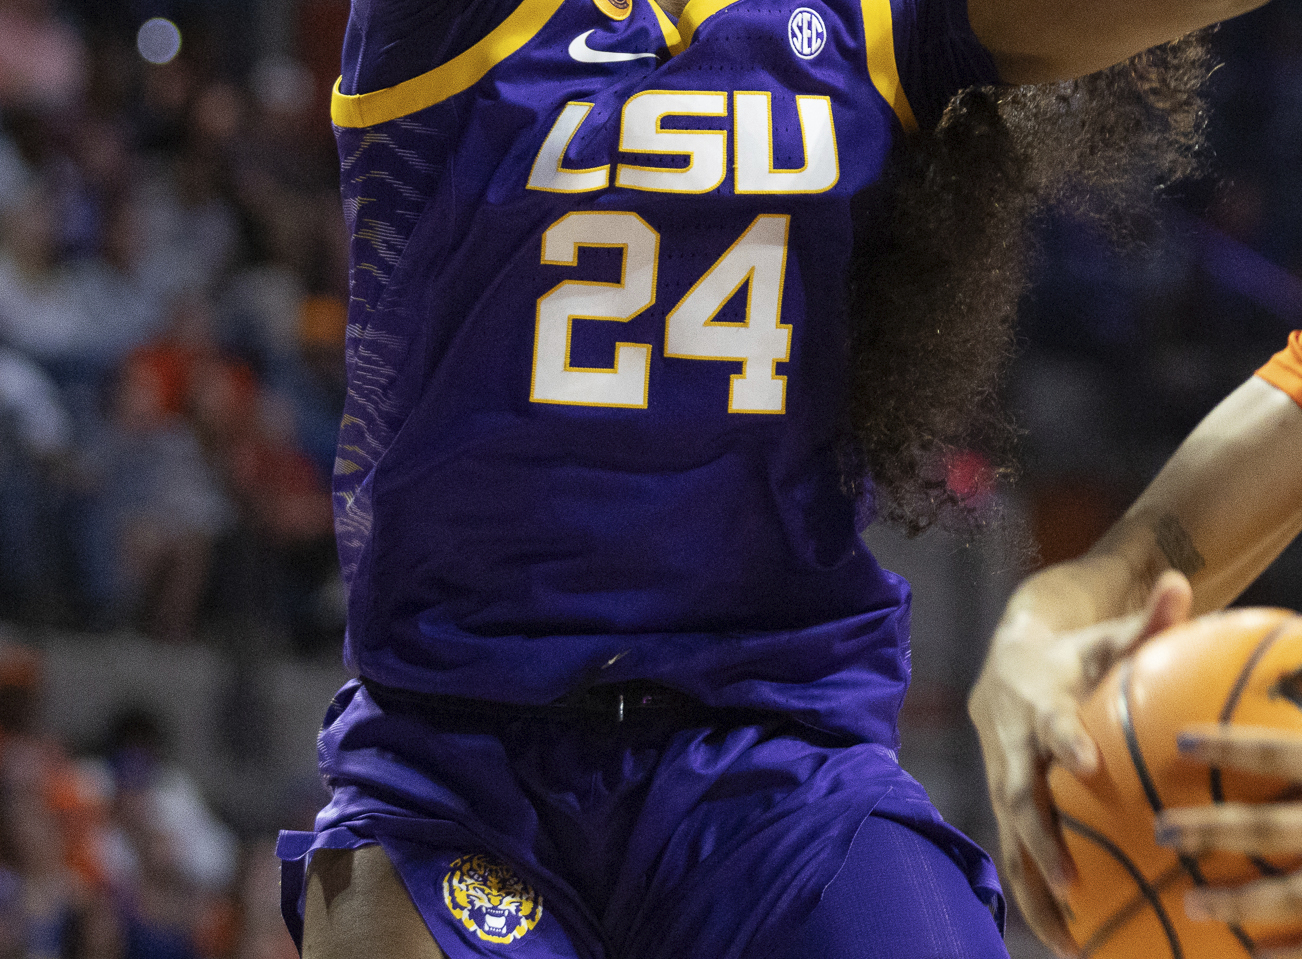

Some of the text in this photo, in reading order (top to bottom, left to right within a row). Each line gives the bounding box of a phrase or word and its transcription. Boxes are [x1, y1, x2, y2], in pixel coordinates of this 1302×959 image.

[791, 11, 824, 55] SEC
[526, 90, 840, 194] LSU
[529, 211, 793, 414] 24
